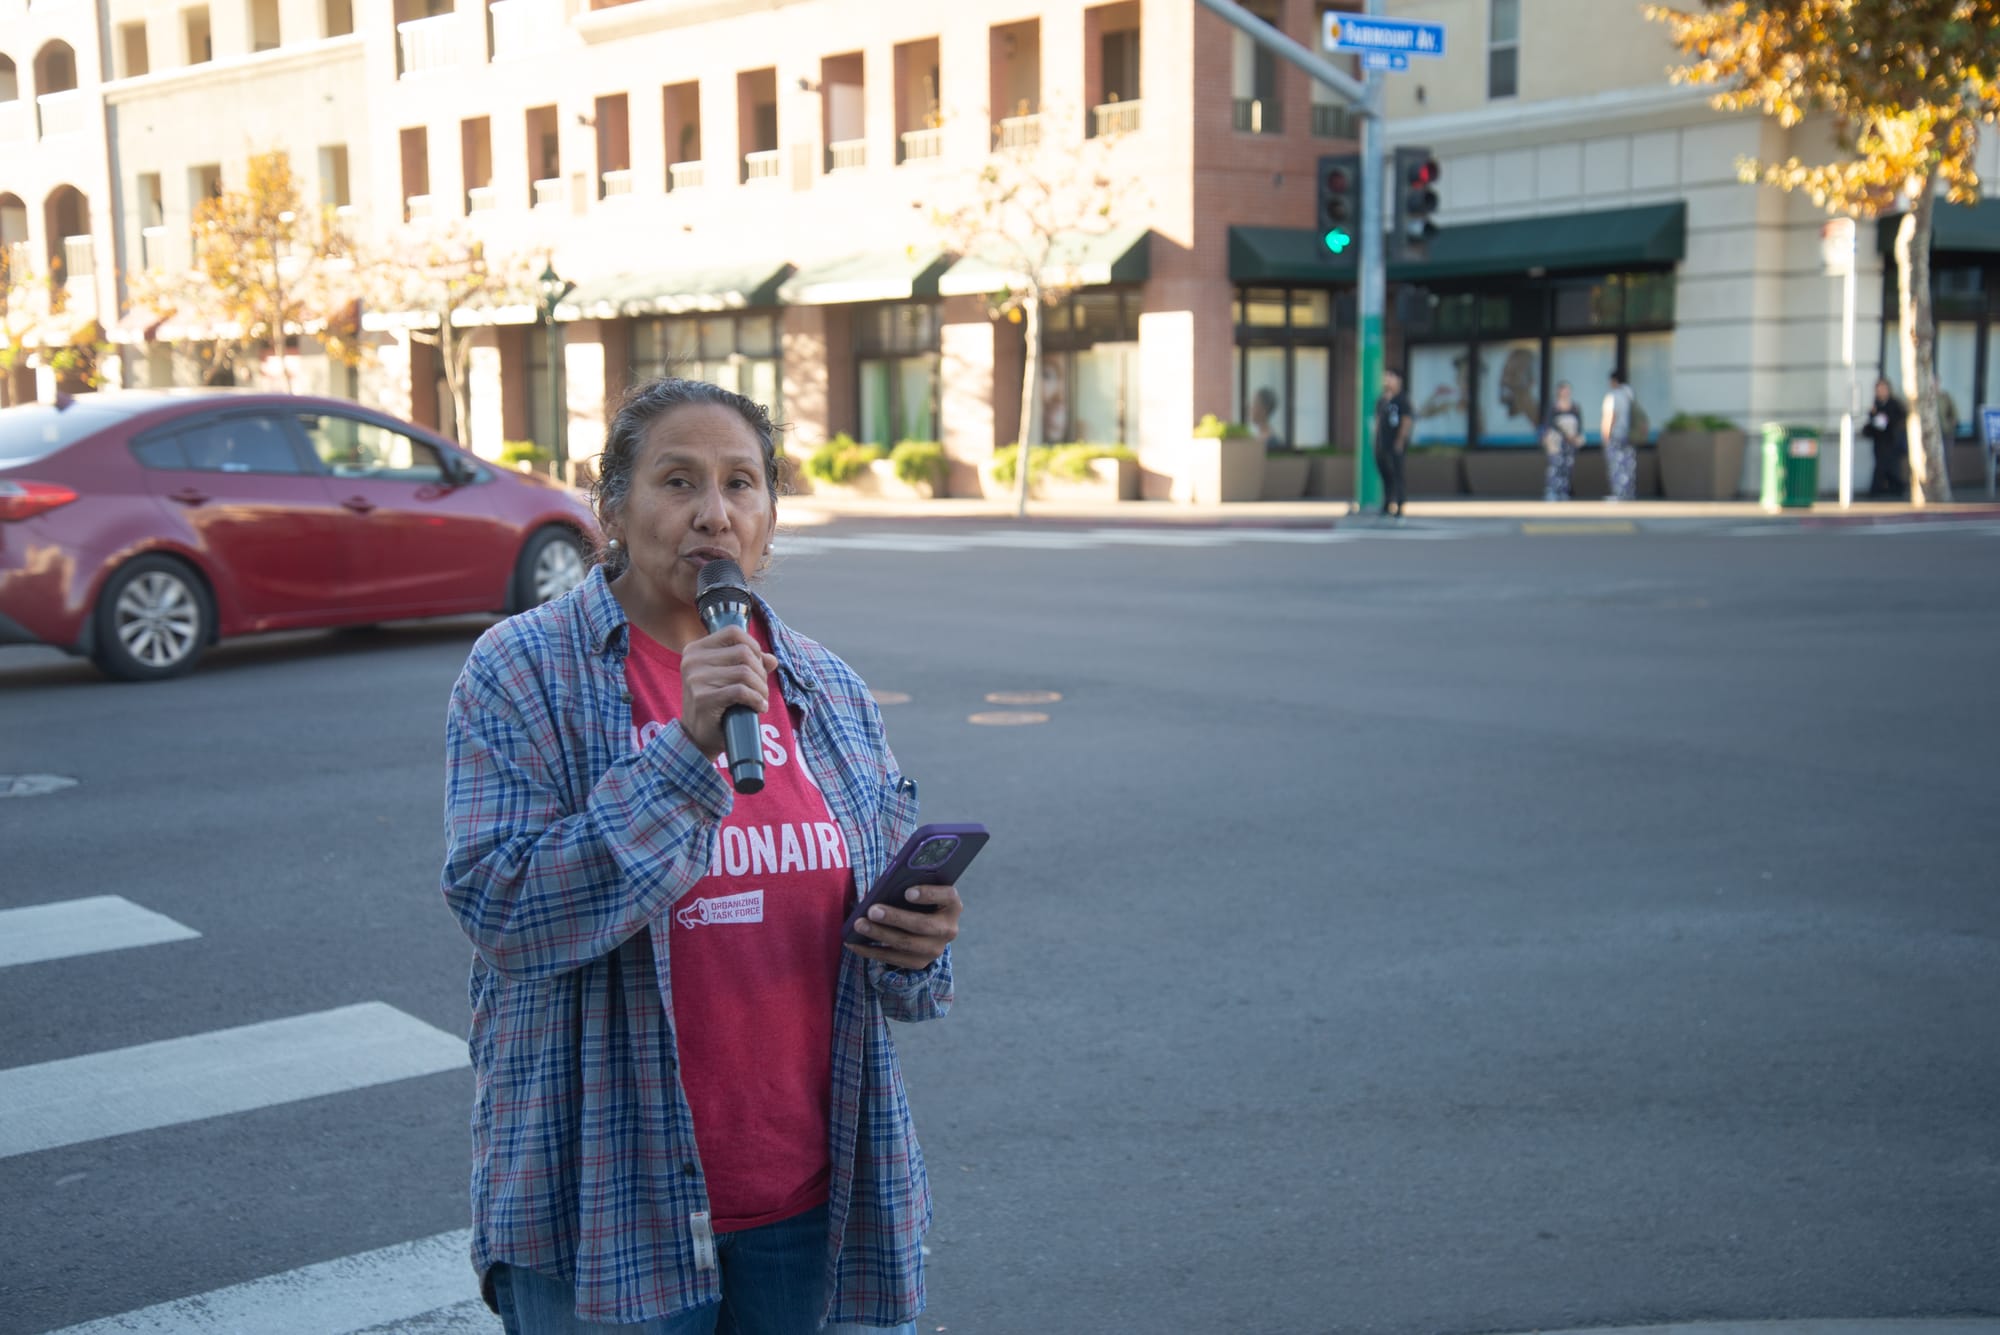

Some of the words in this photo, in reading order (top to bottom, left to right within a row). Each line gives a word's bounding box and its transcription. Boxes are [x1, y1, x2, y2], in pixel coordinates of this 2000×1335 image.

[704, 822, 851, 877] IONAIR
[711, 897, 760, 911] ORGANIZING
[711, 910, 734, 921] TASK
[735, 906, 761, 918] FORCE
